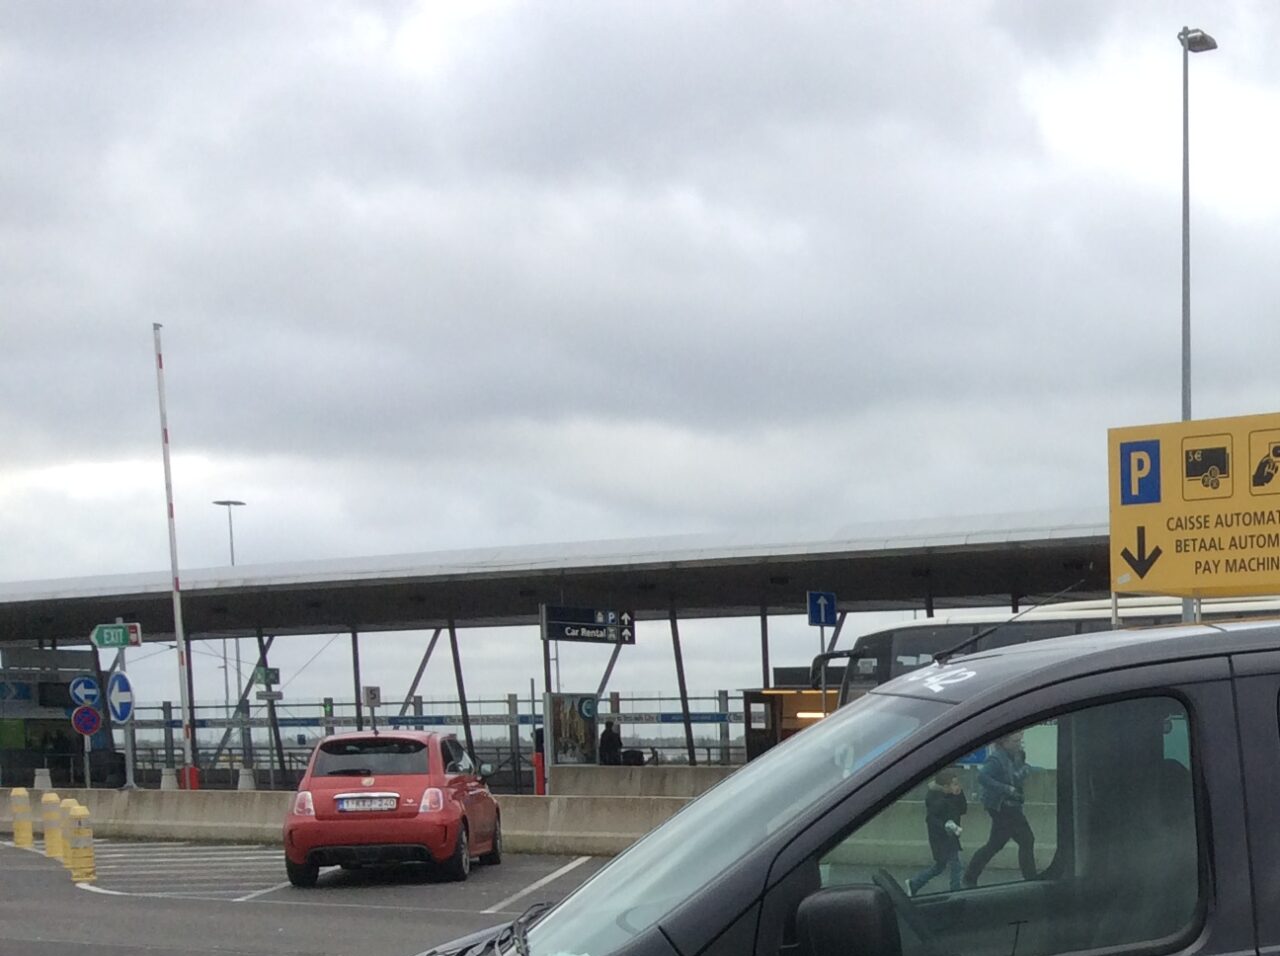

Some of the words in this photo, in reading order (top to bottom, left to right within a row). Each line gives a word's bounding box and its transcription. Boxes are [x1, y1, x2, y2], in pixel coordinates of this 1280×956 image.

[1130, 451, 1151, 497] P
[1166, 511, 1210, 532] CAISSE
[1175, 535, 1224, 554] BETAAL
[1195, 559, 1221, 575] PAY
[103, 629, 123, 645] EXIT
[565, 627, 579, 636] Car
[581, 627, 606, 638] Rental
